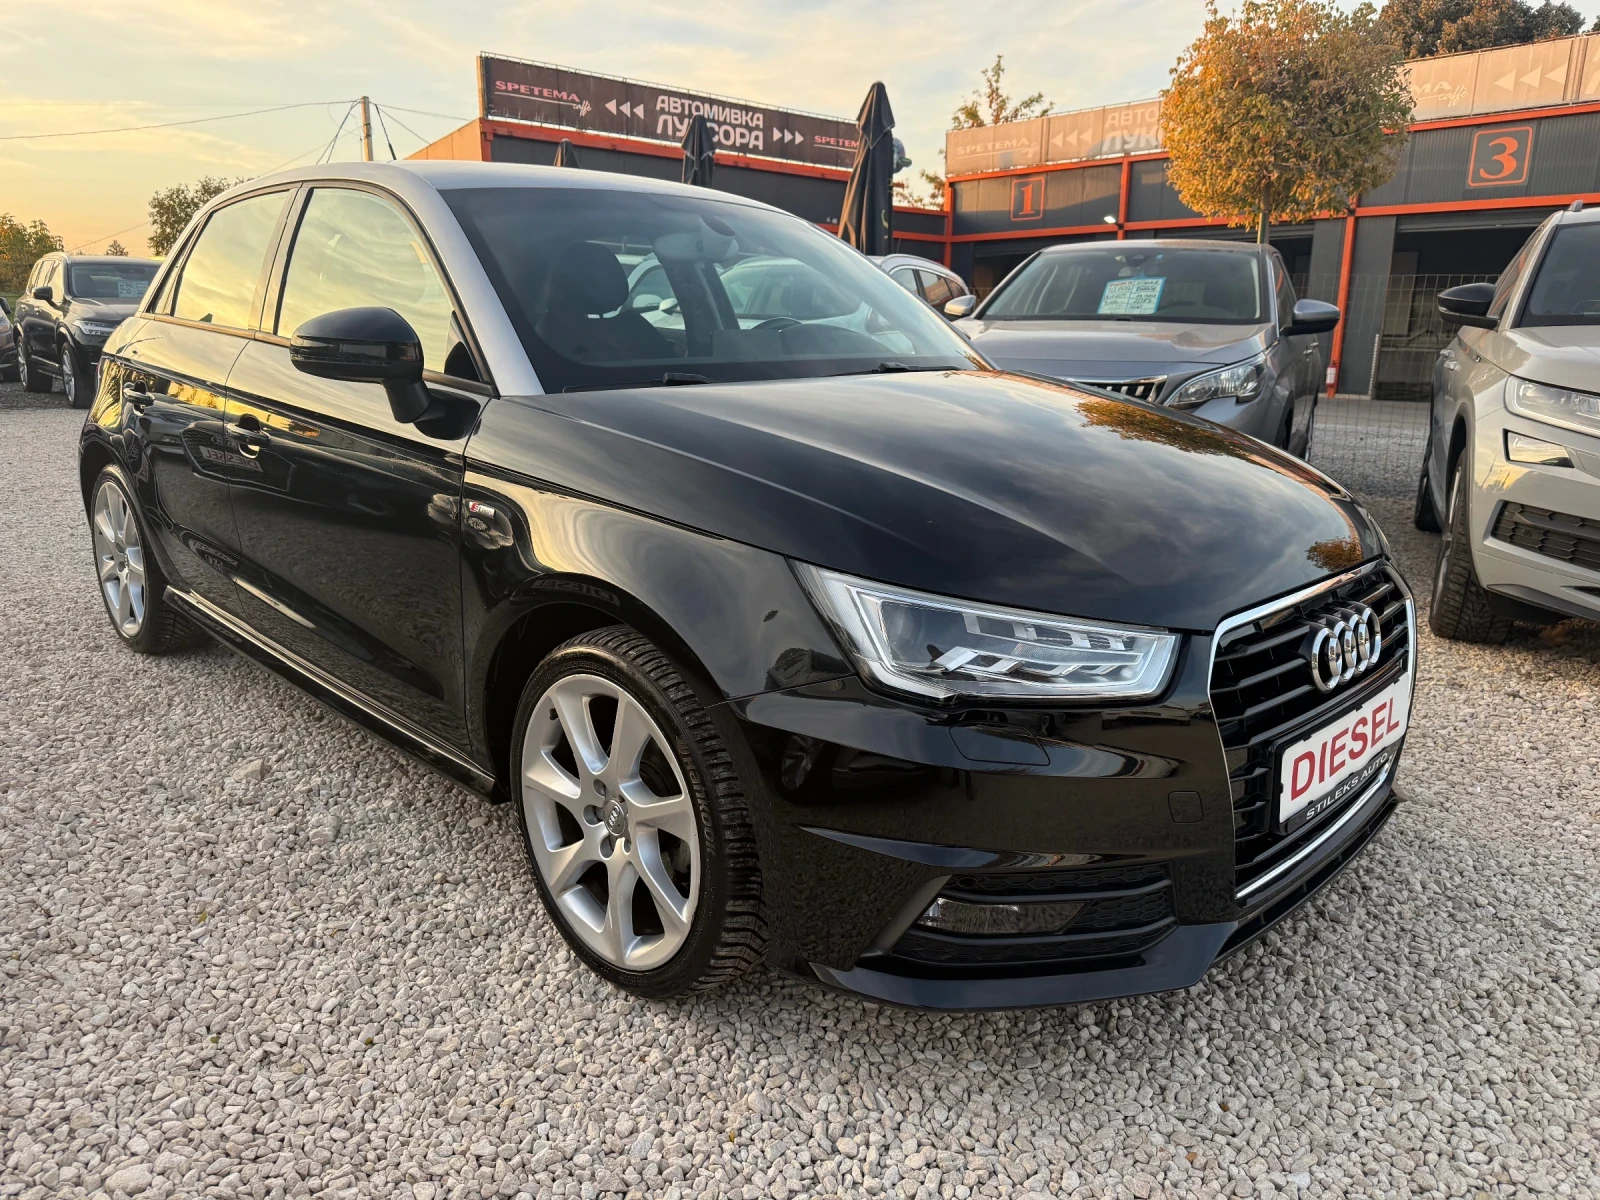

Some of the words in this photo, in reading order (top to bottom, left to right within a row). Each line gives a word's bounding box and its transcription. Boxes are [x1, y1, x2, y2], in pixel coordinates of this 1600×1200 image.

[495, 80, 580, 102] SPETEMA
[656, 95, 764, 128] АВТОМИВКА
[656, 114, 764, 150] ЛУСОРА
[957, 137, 1030, 154] SPETEMA
[1479, 136, 1519, 179] 3
[1018, 184, 1035, 214] 1
[1290, 697, 1400, 802] DIESEL
[1306, 776, 1359, 820] STILEKS
[1360, 752, 1388, 781] AUTO
